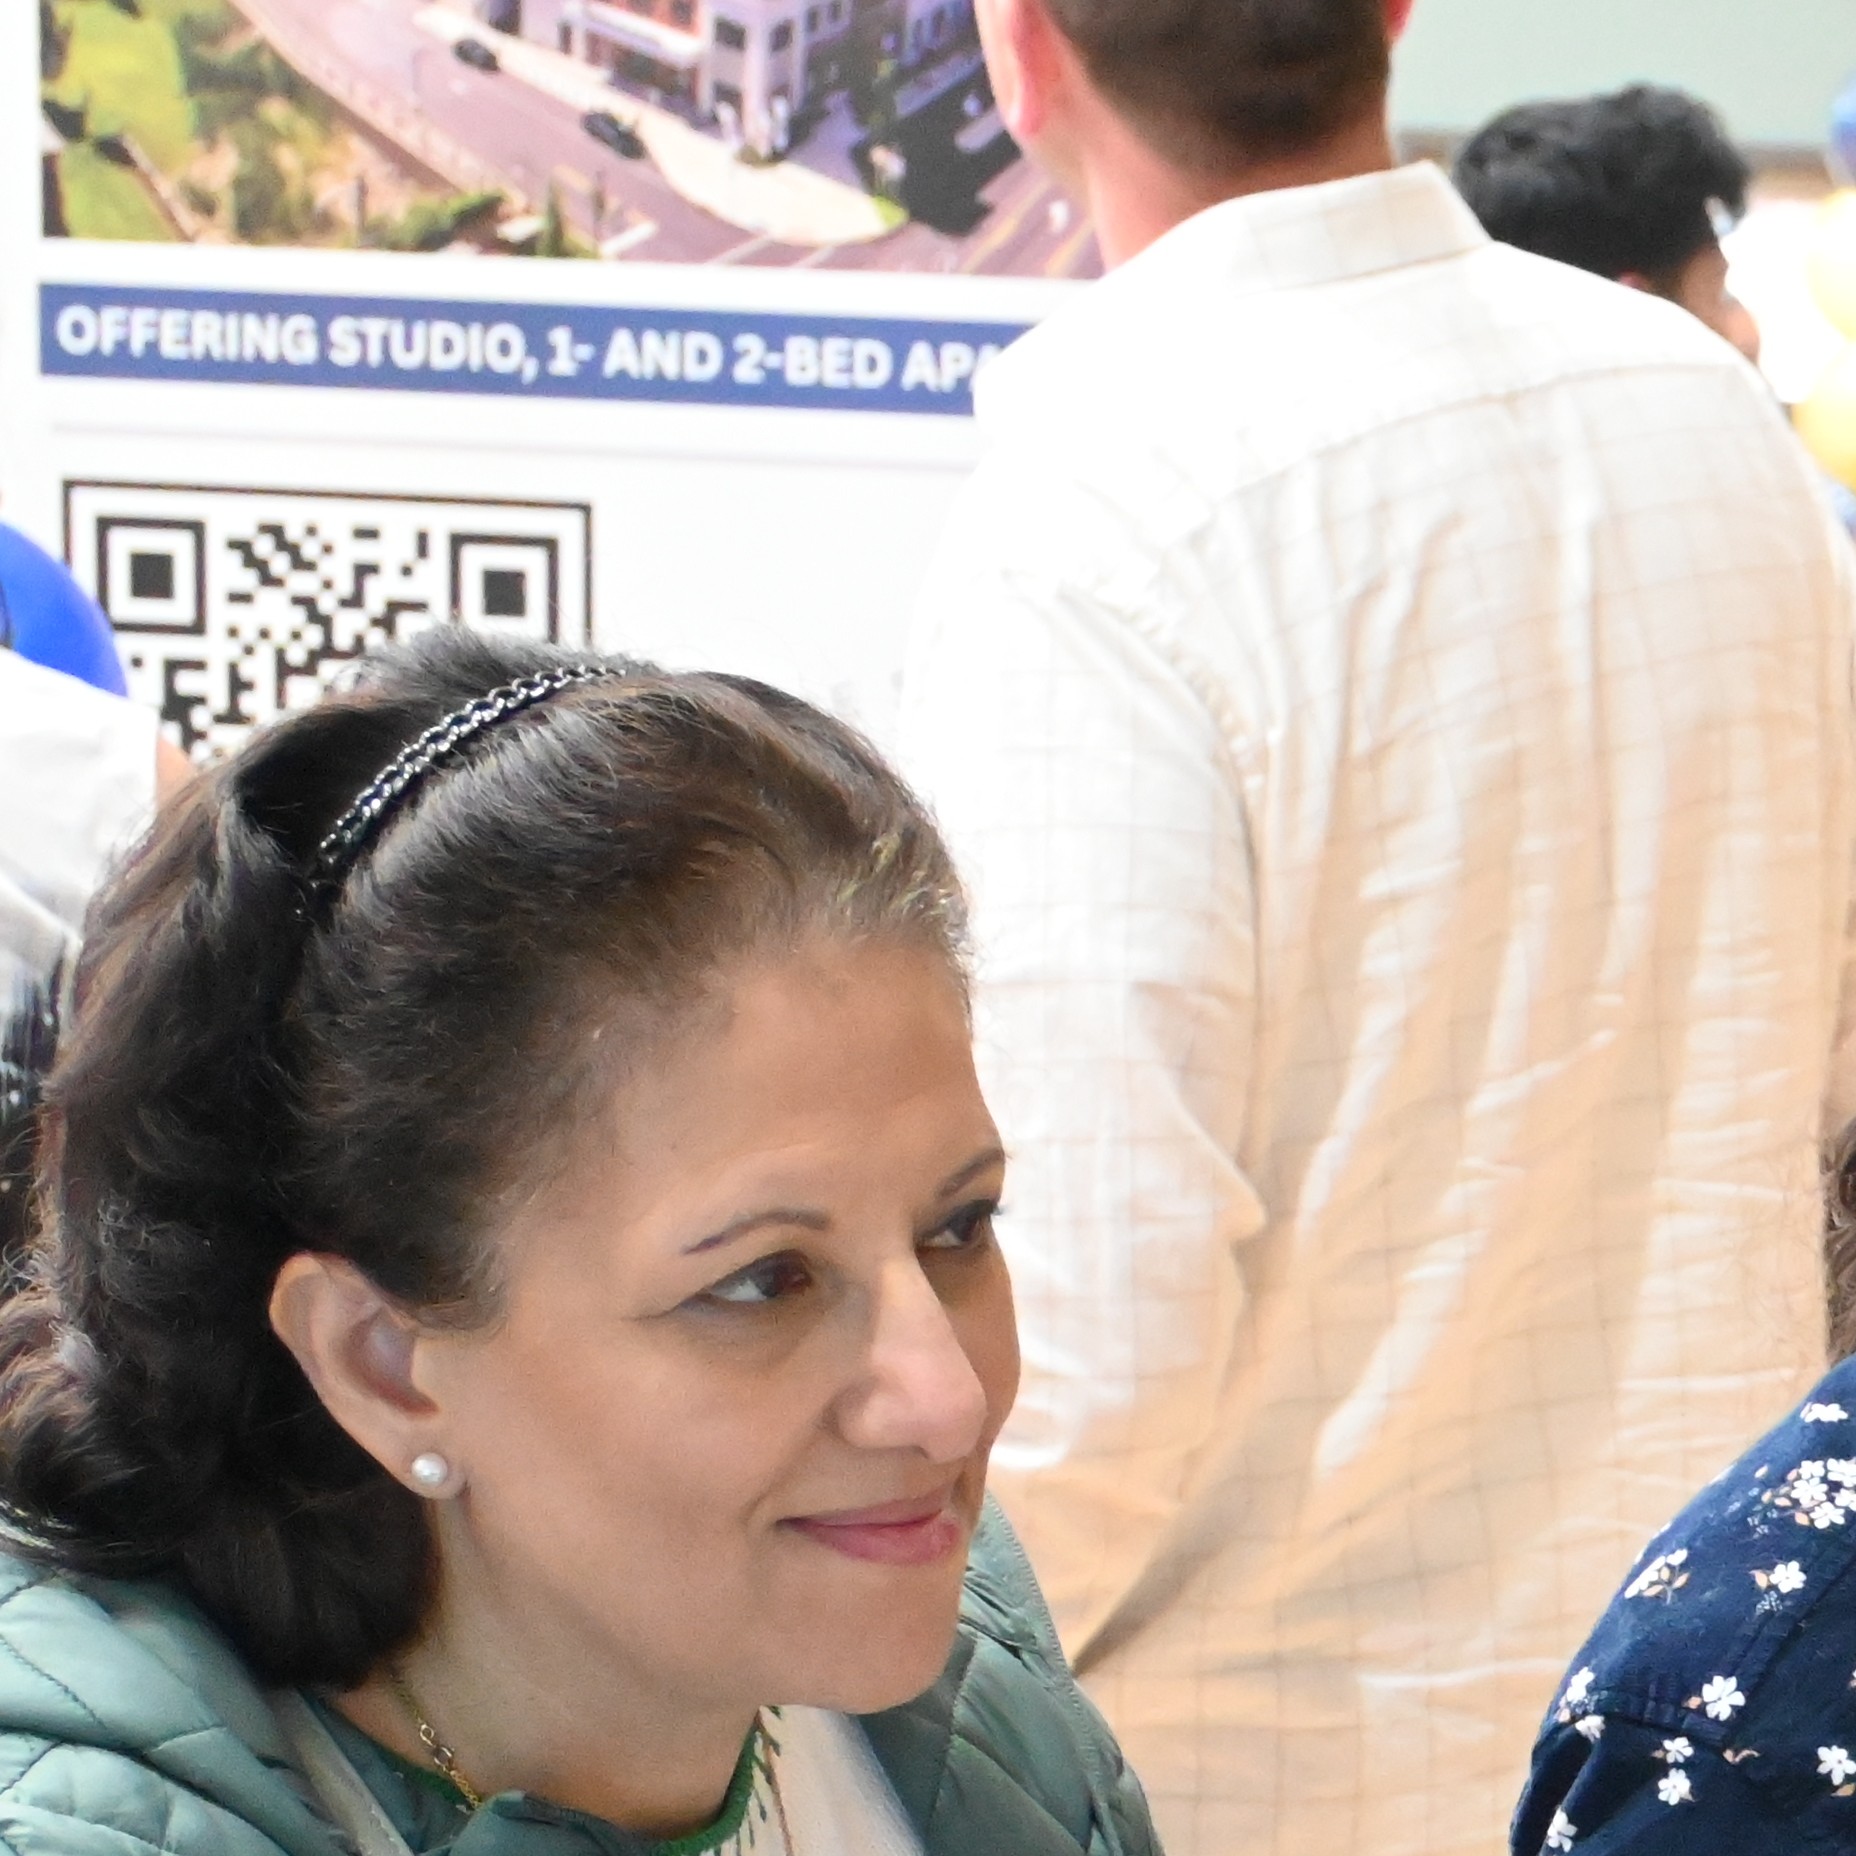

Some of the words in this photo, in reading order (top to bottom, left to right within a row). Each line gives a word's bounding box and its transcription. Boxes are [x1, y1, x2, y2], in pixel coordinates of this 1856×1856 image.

[56, 304, 319, 366] OFFERING
[329, 315, 538, 386] STUDIO,
[546, 326, 596, 376] 1-
[604, 329, 723, 384] AND
[733, 335, 890, 391] 2-BED
